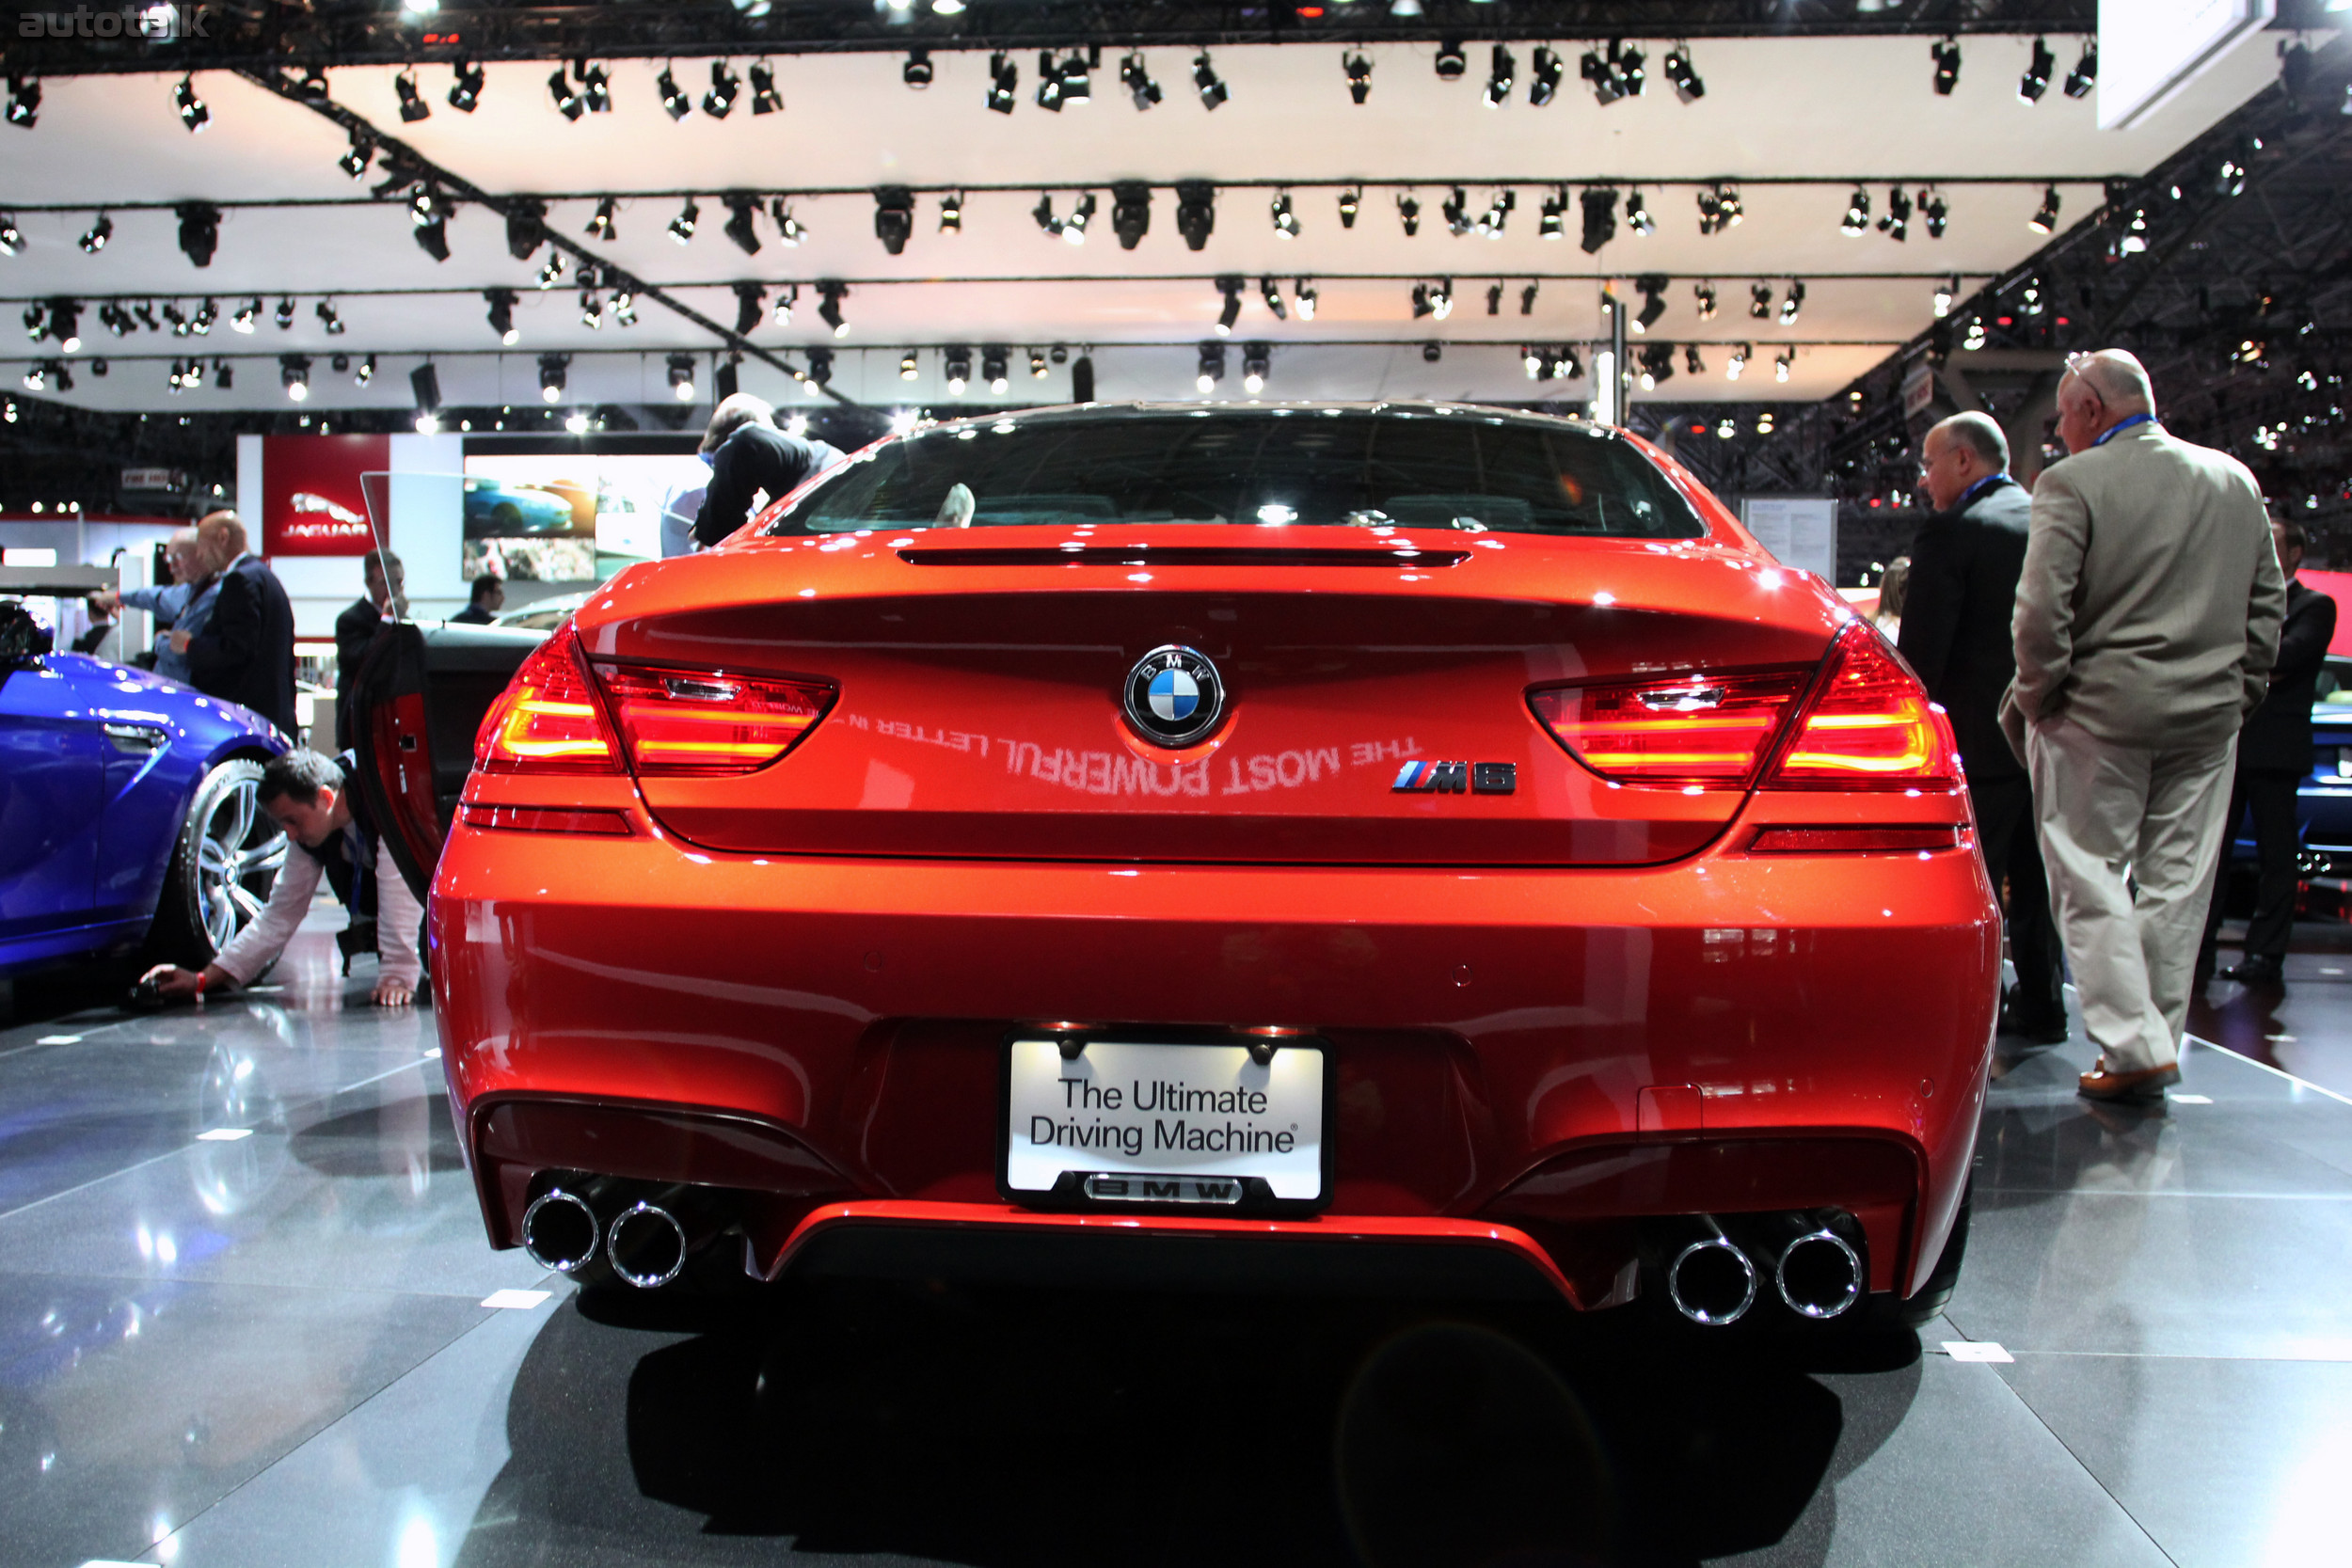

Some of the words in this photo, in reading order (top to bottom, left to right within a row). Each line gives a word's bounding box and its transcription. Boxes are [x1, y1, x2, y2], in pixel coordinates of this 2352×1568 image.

[281, 524, 368, 537] JAGUAR
[1140, 654, 1210, 681] BMW
[878, 719, 989, 757] LETTER
[1351, 736, 1423, 766] THE
[1222, 748, 1341, 796] MOST
[1422, 760, 1516, 790] M6
[1058, 1078, 1122, 1111] The
[1134, 1080, 1267, 1114] Ultimate
[1030, 1116, 1143, 1156] Driving
[1091, 1179, 1233, 1199] BMW
